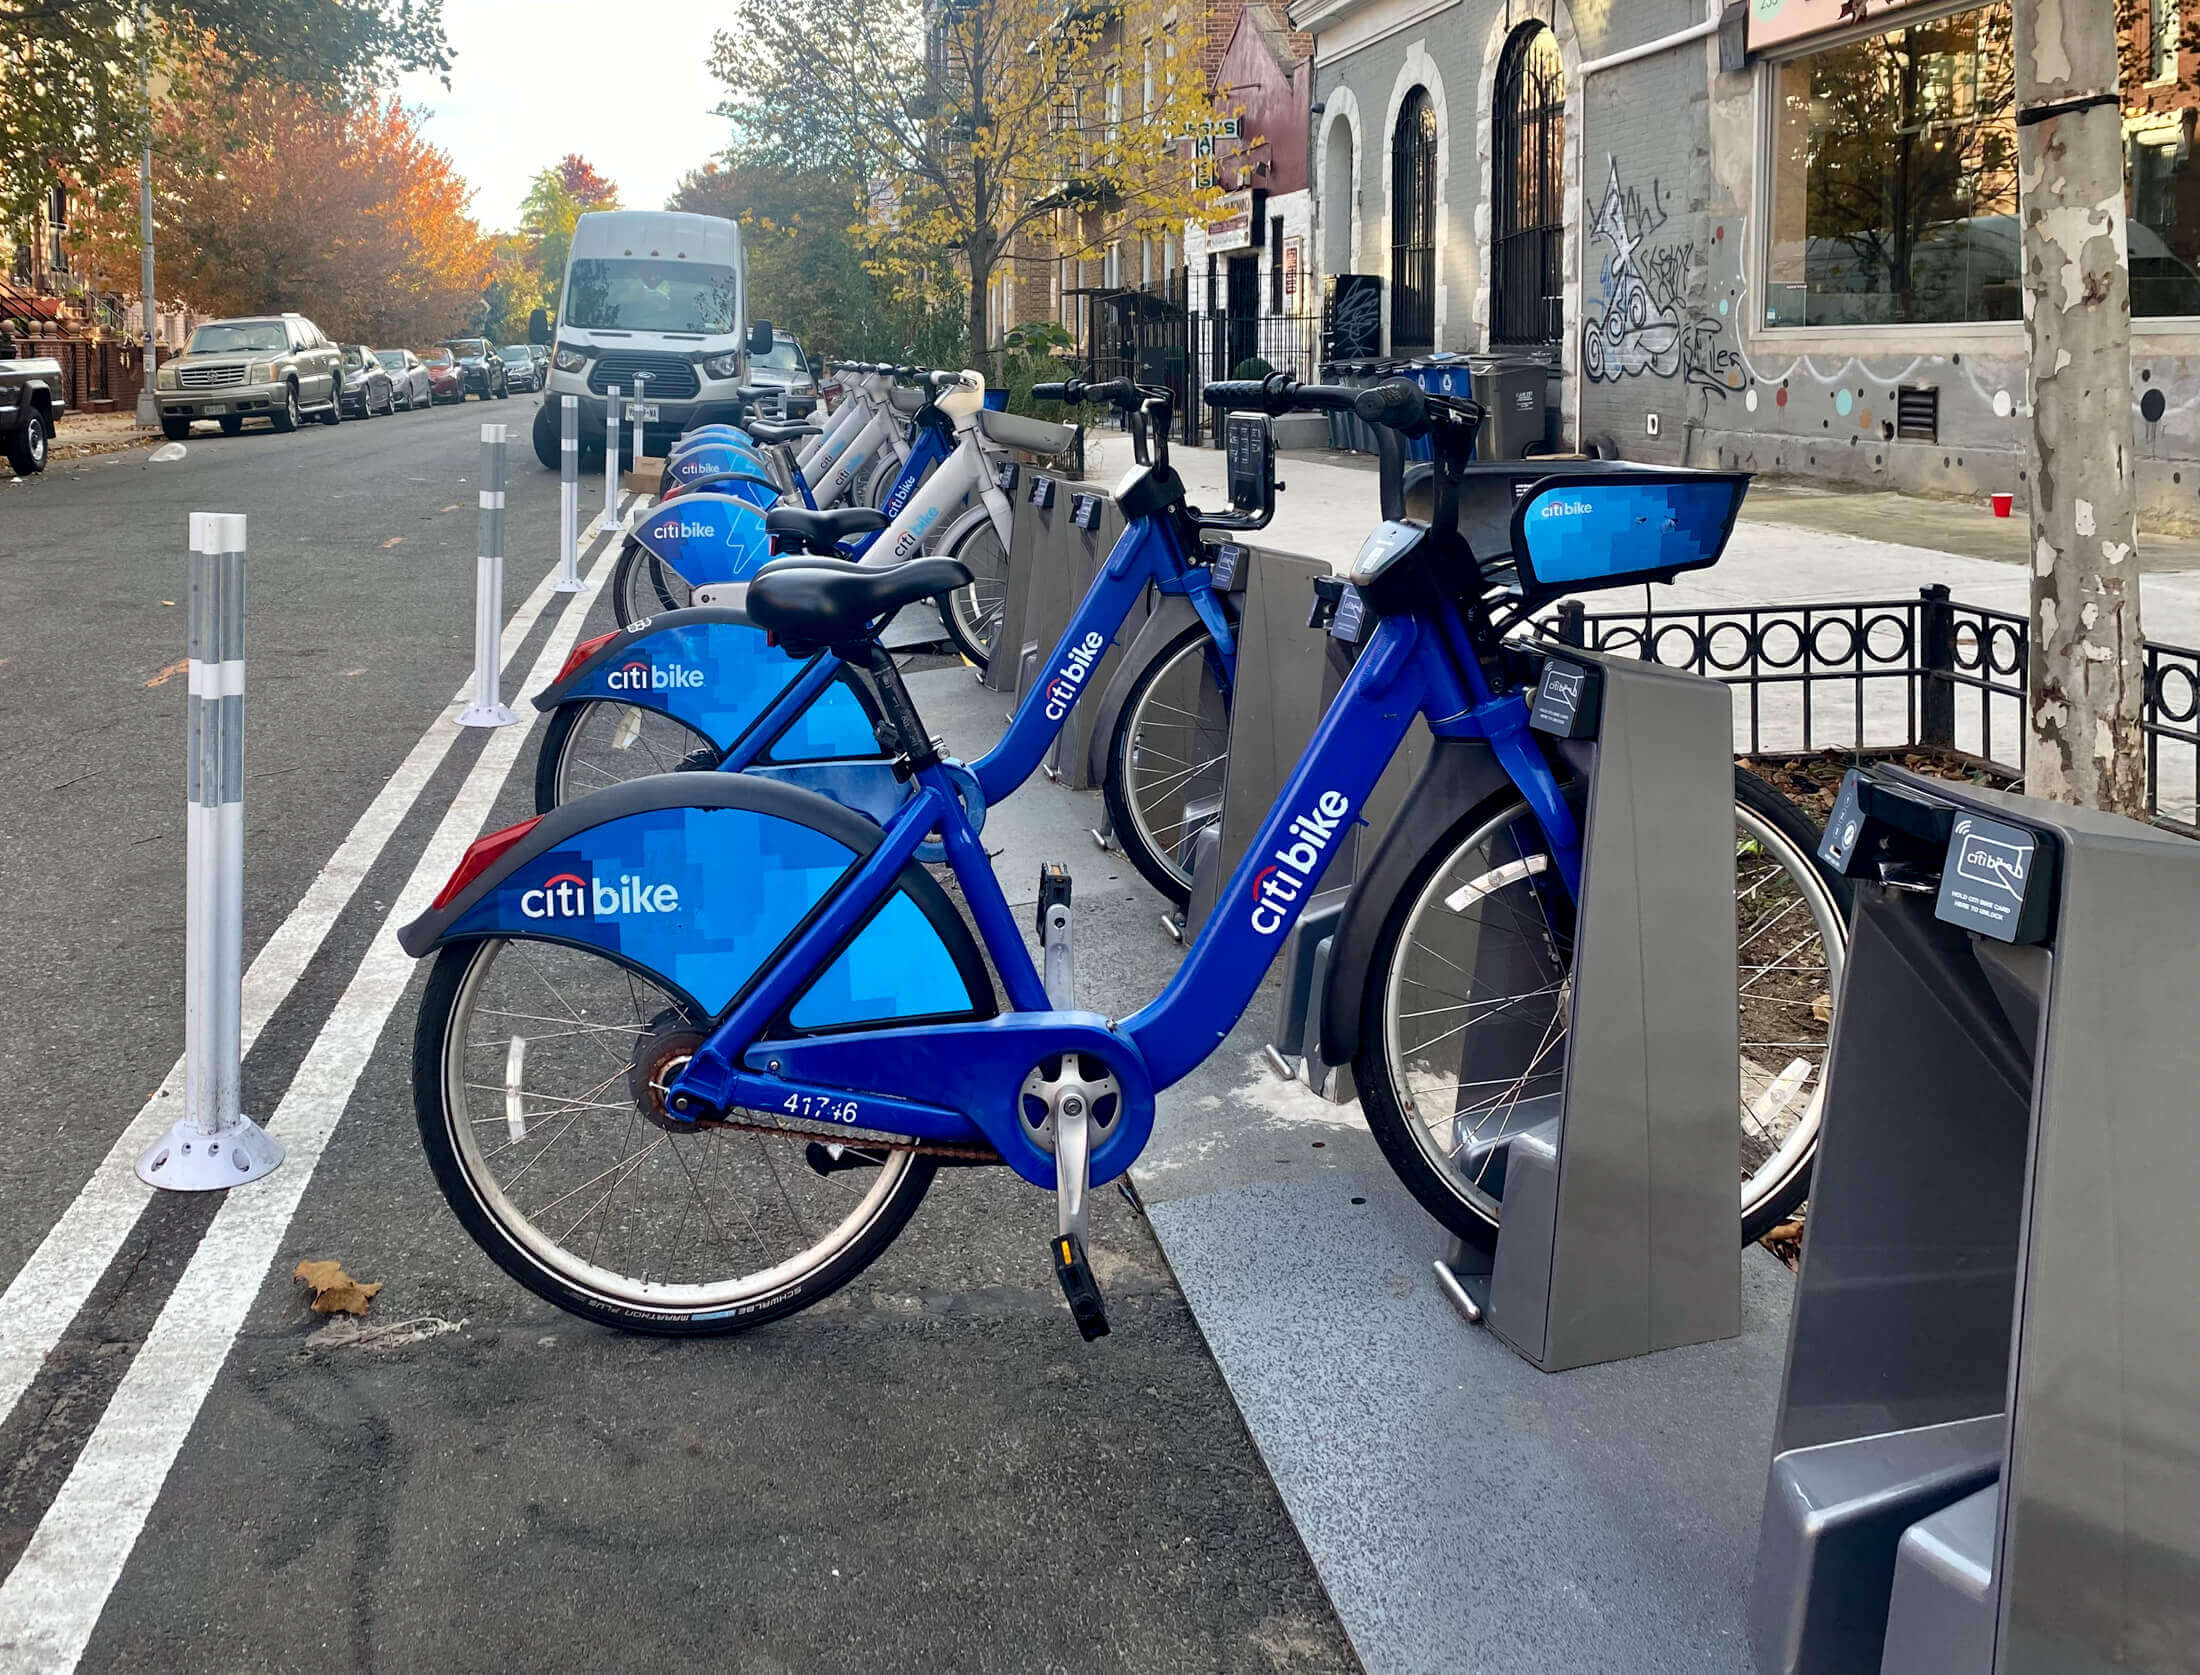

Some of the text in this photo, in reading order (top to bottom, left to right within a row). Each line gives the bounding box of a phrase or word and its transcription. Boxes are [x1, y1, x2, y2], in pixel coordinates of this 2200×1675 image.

[888, 476, 916, 518] citi bike
[1541, 501, 1593, 518] citi bike
[654, 521, 715, 539] citi bike
[894, 531, 916, 557] citi
[608, 662, 705, 690] citi bike
[1045, 631, 1104, 721] citi bike
[1251, 790, 1349, 935] citi bike
[1967, 850, 1988, 867] citi
[520, 873, 679, 918] citi bike
[624, 1309, 689, 1321] MARATHON
